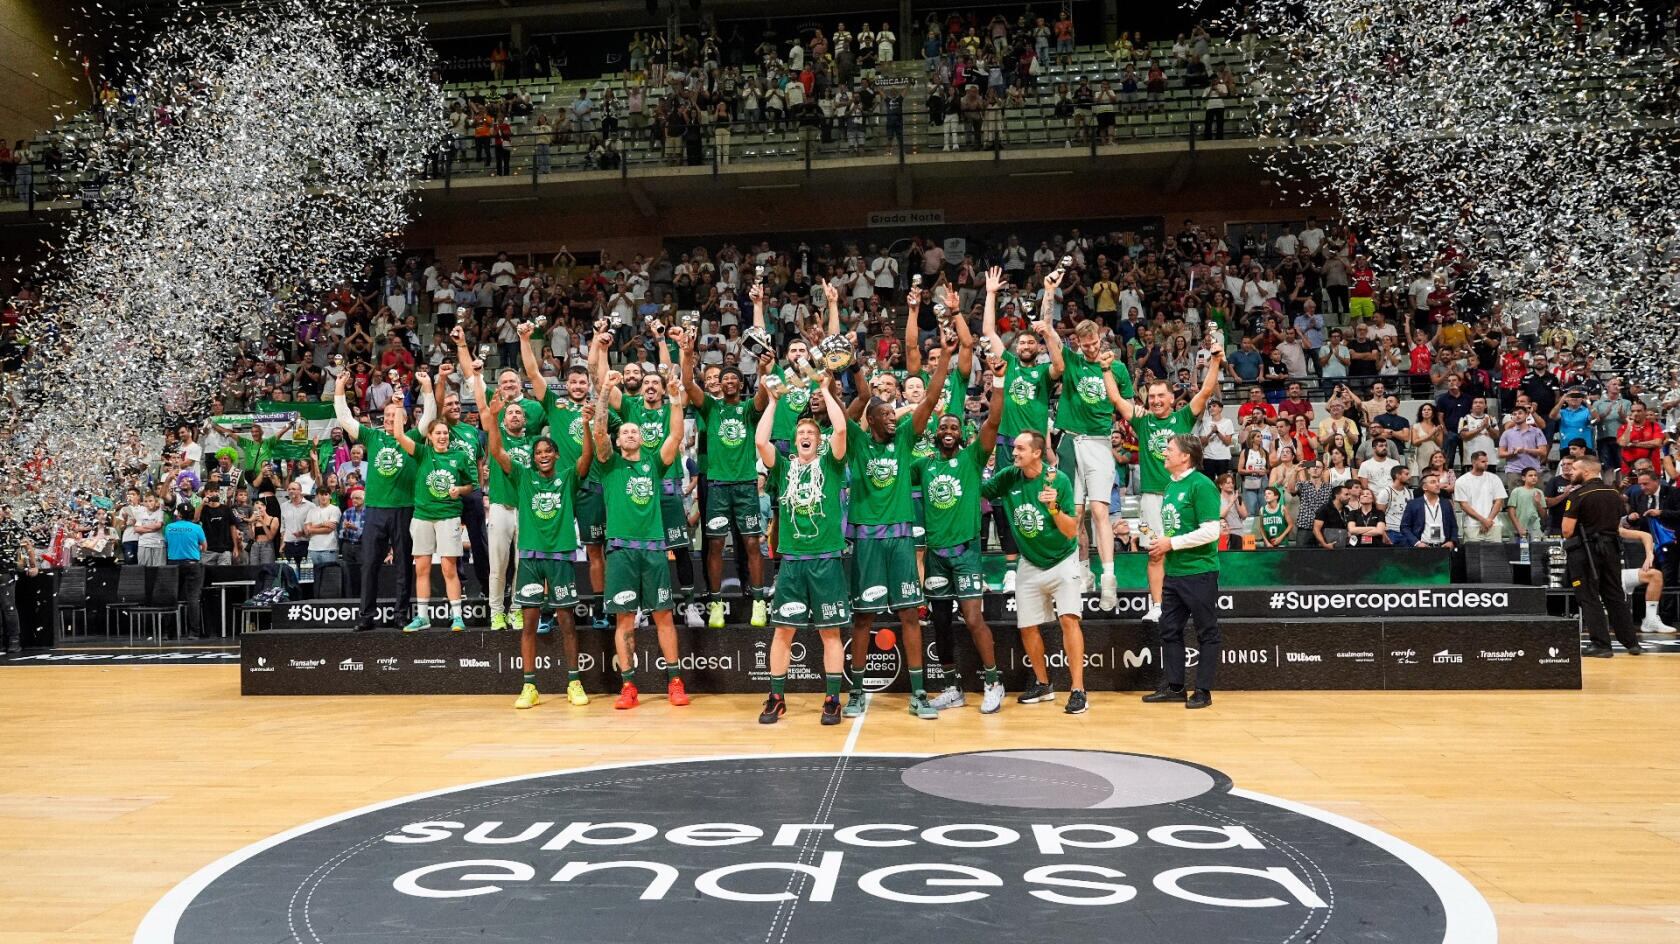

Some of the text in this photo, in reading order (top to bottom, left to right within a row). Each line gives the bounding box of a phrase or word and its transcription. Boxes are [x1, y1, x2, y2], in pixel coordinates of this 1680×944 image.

[871, 211, 941, 224] Grada Norte
[1263, 516, 1283, 525] BOSTON
[1269, 526, 1278, 536] 0
[1269, 590, 1509, 612] #SupercopaEndesa
[1221, 650, 1268, 664] IONOS
[1286, 652, 1322, 662] Wilson
[1390, 649, 1416, 659] renfe
[1480, 650, 1517, 658] Transaher
[376, 657, 398, 665] renfe
[459, 658, 490, 668] Wilson
[510, 656, 551, 669] IOOS
[655, 652, 732, 670] edesa
[1432, 656, 1463, 664] LOTUS
[384, 821, 1266, 855] supercopa
[393, 851, 1329, 909] endesa
